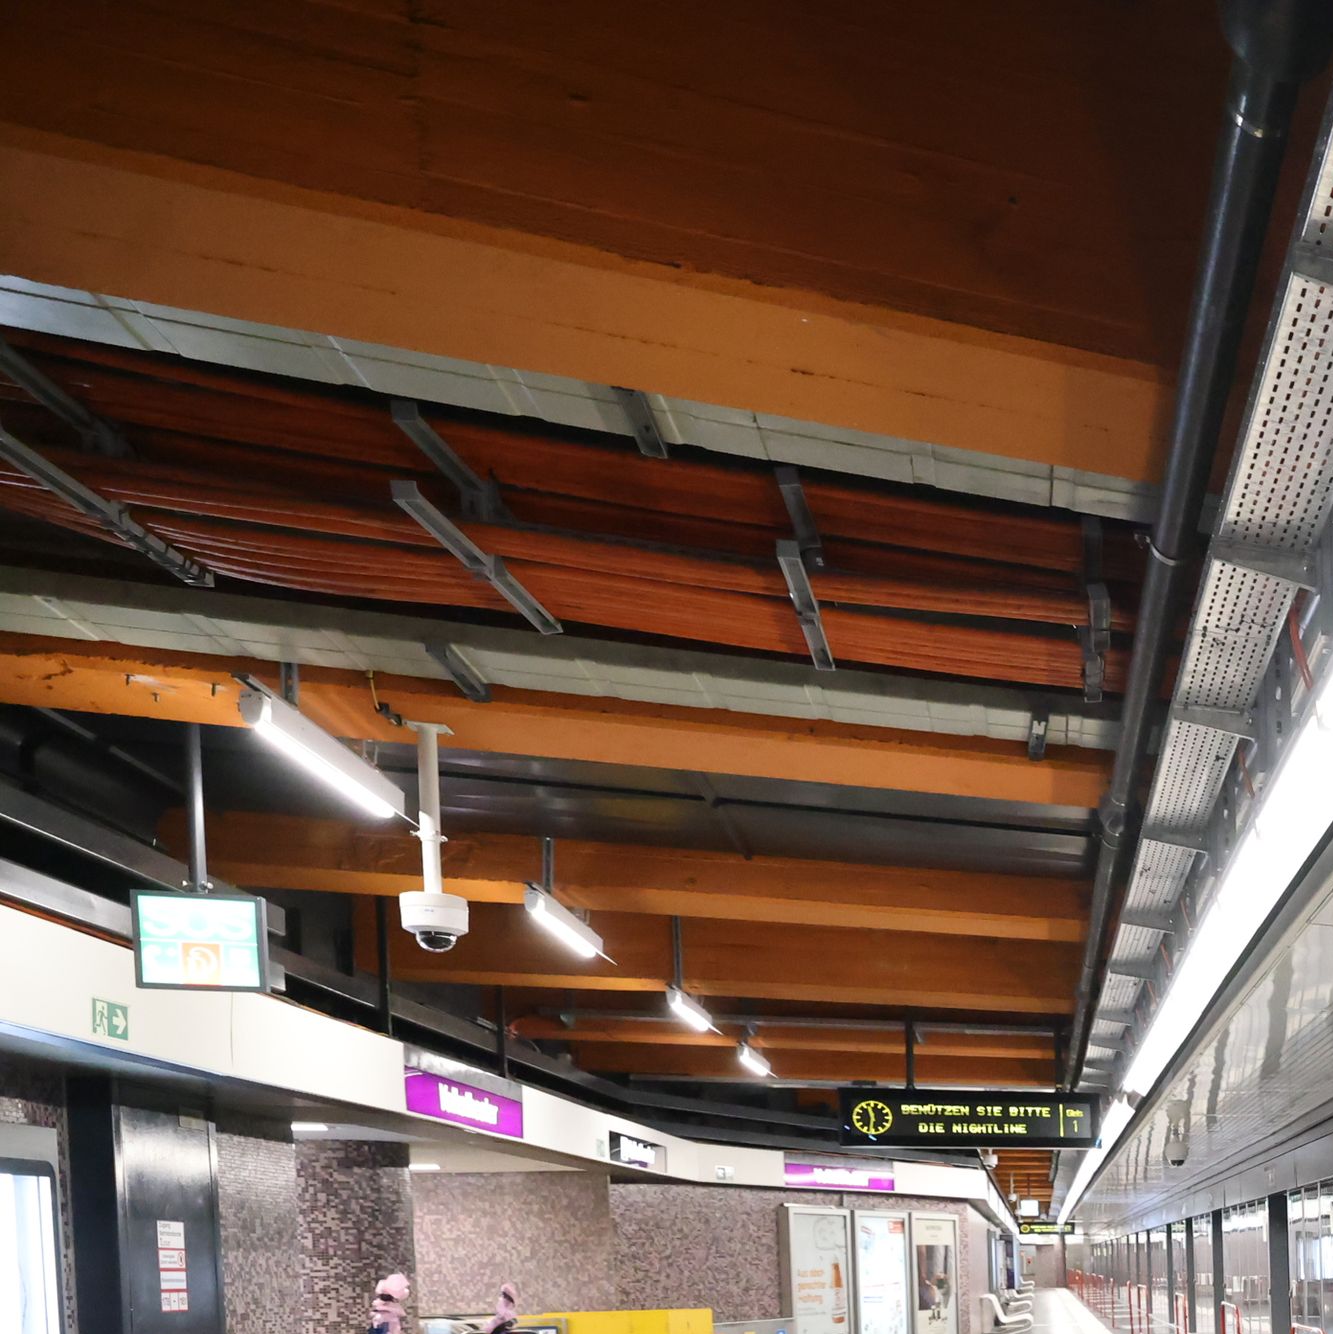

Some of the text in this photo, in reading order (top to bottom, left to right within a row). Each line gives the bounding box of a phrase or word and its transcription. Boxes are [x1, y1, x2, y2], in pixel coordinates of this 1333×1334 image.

[901, 1103, 1051, 1118] BENÜTZEN SIE BITTE
[918, 1122, 1028, 1134] DIE NIGHTLINE
[1072, 1120, 1079, 1133] 1
